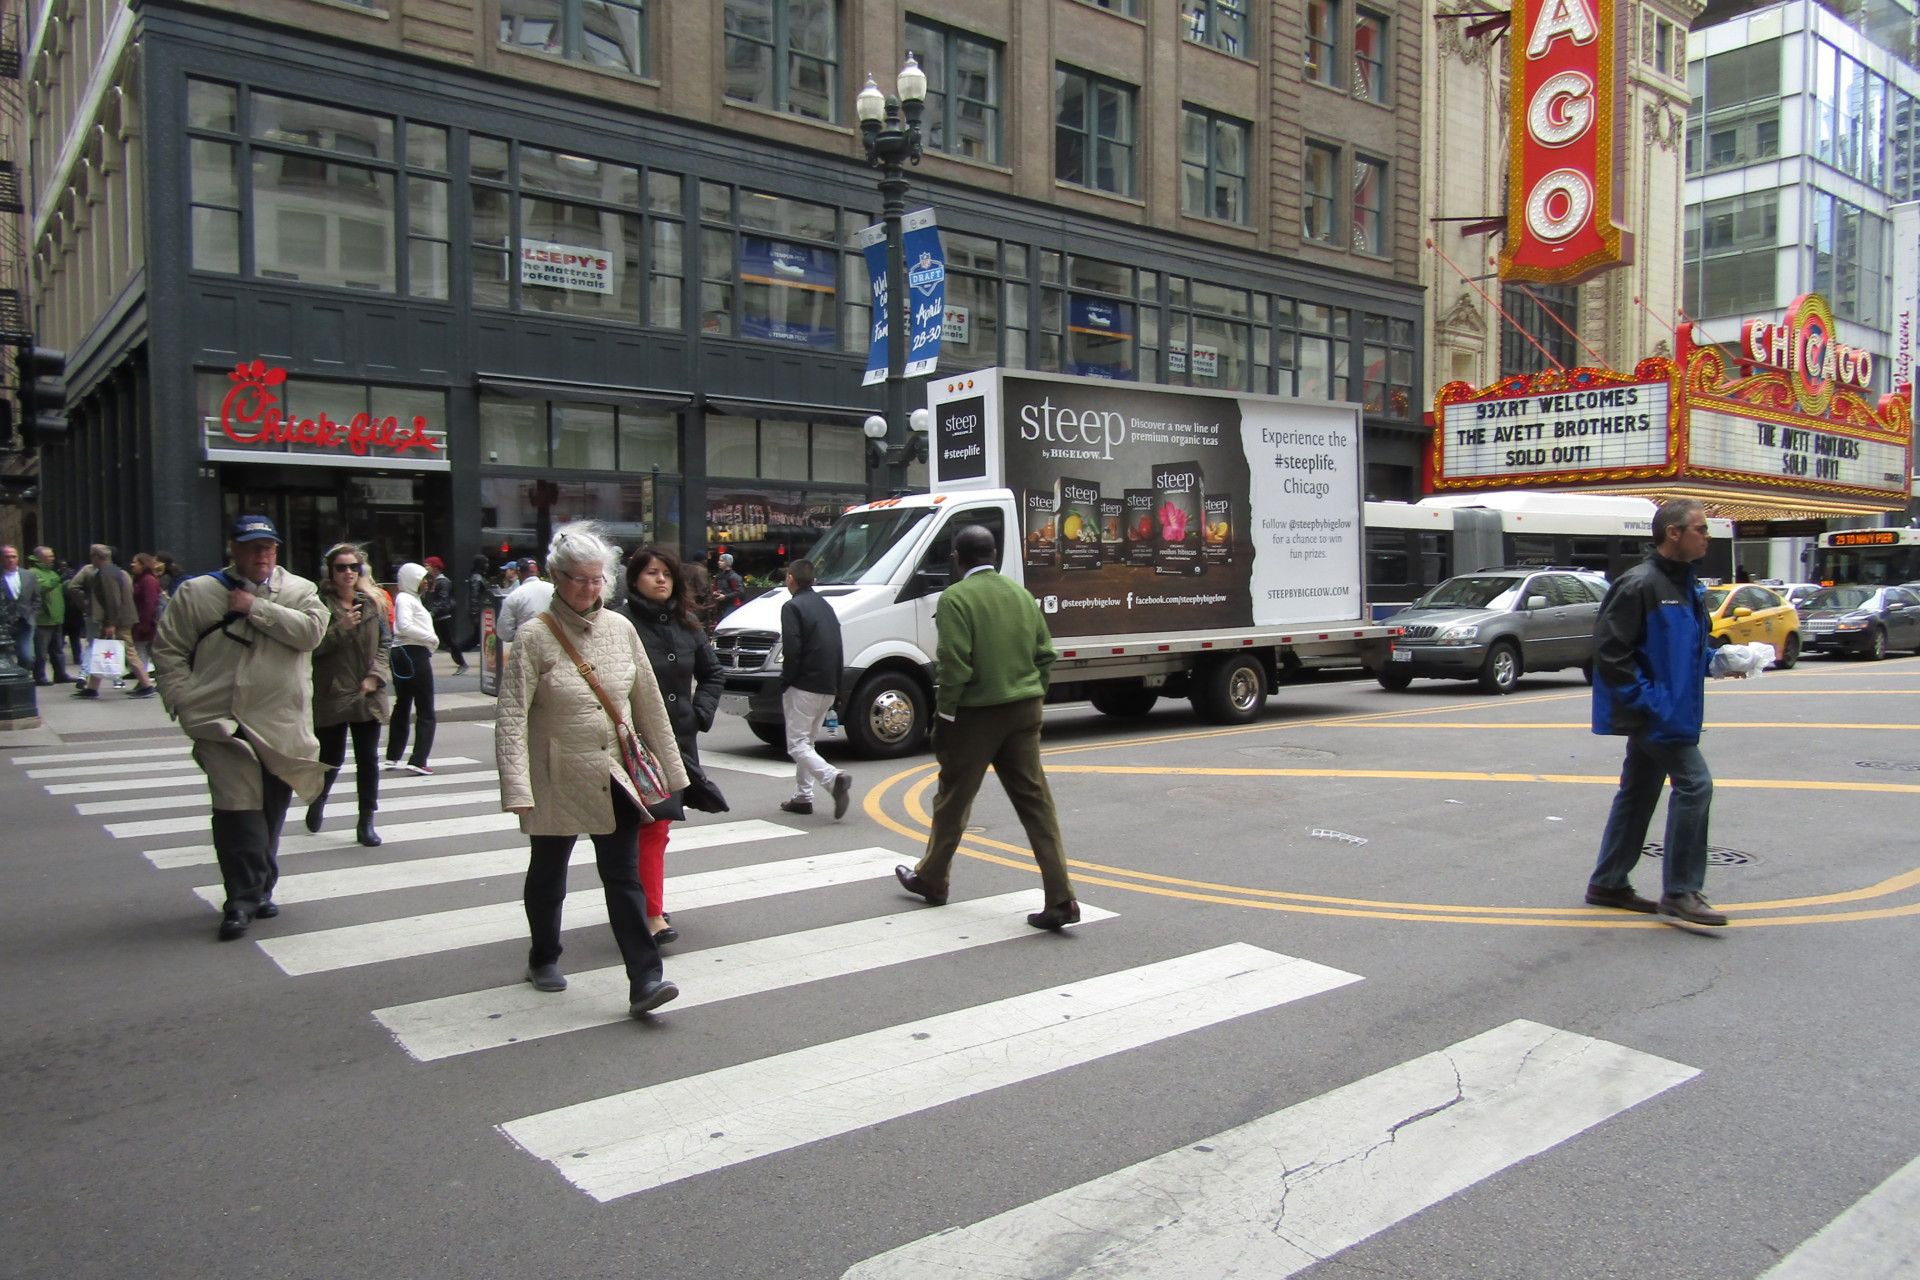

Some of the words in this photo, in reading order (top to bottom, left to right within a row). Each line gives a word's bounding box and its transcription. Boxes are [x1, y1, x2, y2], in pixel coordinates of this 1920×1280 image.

[520, 248, 607, 270] LEEPY'S
[522, 272, 605, 289] rofessionals
[544, 265, 603, 280] Mattress
[912, 270, 941, 283] DRAFT
[916, 297, 942, 328] April
[912, 325, 941, 351] 28-30
[1750, 317, 1873, 388] CHICAGO
[1477, 399, 1529, 419] 93XRT
[1538, 388, 1638, 414] WELCOMES
[221, 378, 440, 456] Chick-fil-A
[945, 414, 977, 434] steep
[1131, 418, 1166, 431] Discover
[1167, 423, 1173, 431] a
[1174, 423, 1192, 433] new
[1194, 422, 1209, 434] line
[1210, 423, 1219, 434] of
[1020, 396, 1126, 461] steep
[1262, 428, 1325, 448] Experience
[1328, 431, 1347, 447] the
[1457, 428, 1486, 445] THE
[1493, 423, 1545, 443] AVETT
[1554, 414, 1650, 438] BROTHERS
[1131, 431, 1169, 443] premium
[1171, 434, 1200, 447] organic
[1202, 435, 1219, 446] teas
[1757, 422, 1776, 447] THE
[1781, 427, 1810, 452] AVETT
[1814, 434, 1860, 460] BROTHERS
[943, 444, 981, 460] #steeplife
[1042, 450, 1050, 459] by
[1505, 450, 1546, 466] SOLD
[1552, 446, 1591, 464] OUT!
[1274, 453, 1337, 474] #steeplife,
[1782, 452, 1808, 475] SOLD
[1815, 457, 1839, 480] OUT!
[1156, 471, 1194, 493] steep
[1284, 477, 1330, 499] Chicago
[1065, 484, 1098, 505] steep
[1262, 519, 1287, 529] Follow
[1289, 518, 1352, 533] @steepbybigelow
[1272, 534, 1283, 544] for
[1292, 533, 1317, 544] chance
[1319, 535, 1327, 544] to
[1329, 534, 1342, 543] win
[1836, 536, 1845, 545] 29
[1847, 535, 1855, 544] TO
[1856, 534, 1873, 544] NAVY
[1876, 533, 1893, 543] PIER
[1290, 549, 1302, 559] fun
[1304, 549, 1327, 561] prizes.
[1061, 598, 1121, 609] @steepbybigelow
[1135, 594, 1227, 605] facebook.com/steepbybigelow
[1267, 586, 1349, 600] STEEPBYBIGELOW.COM
